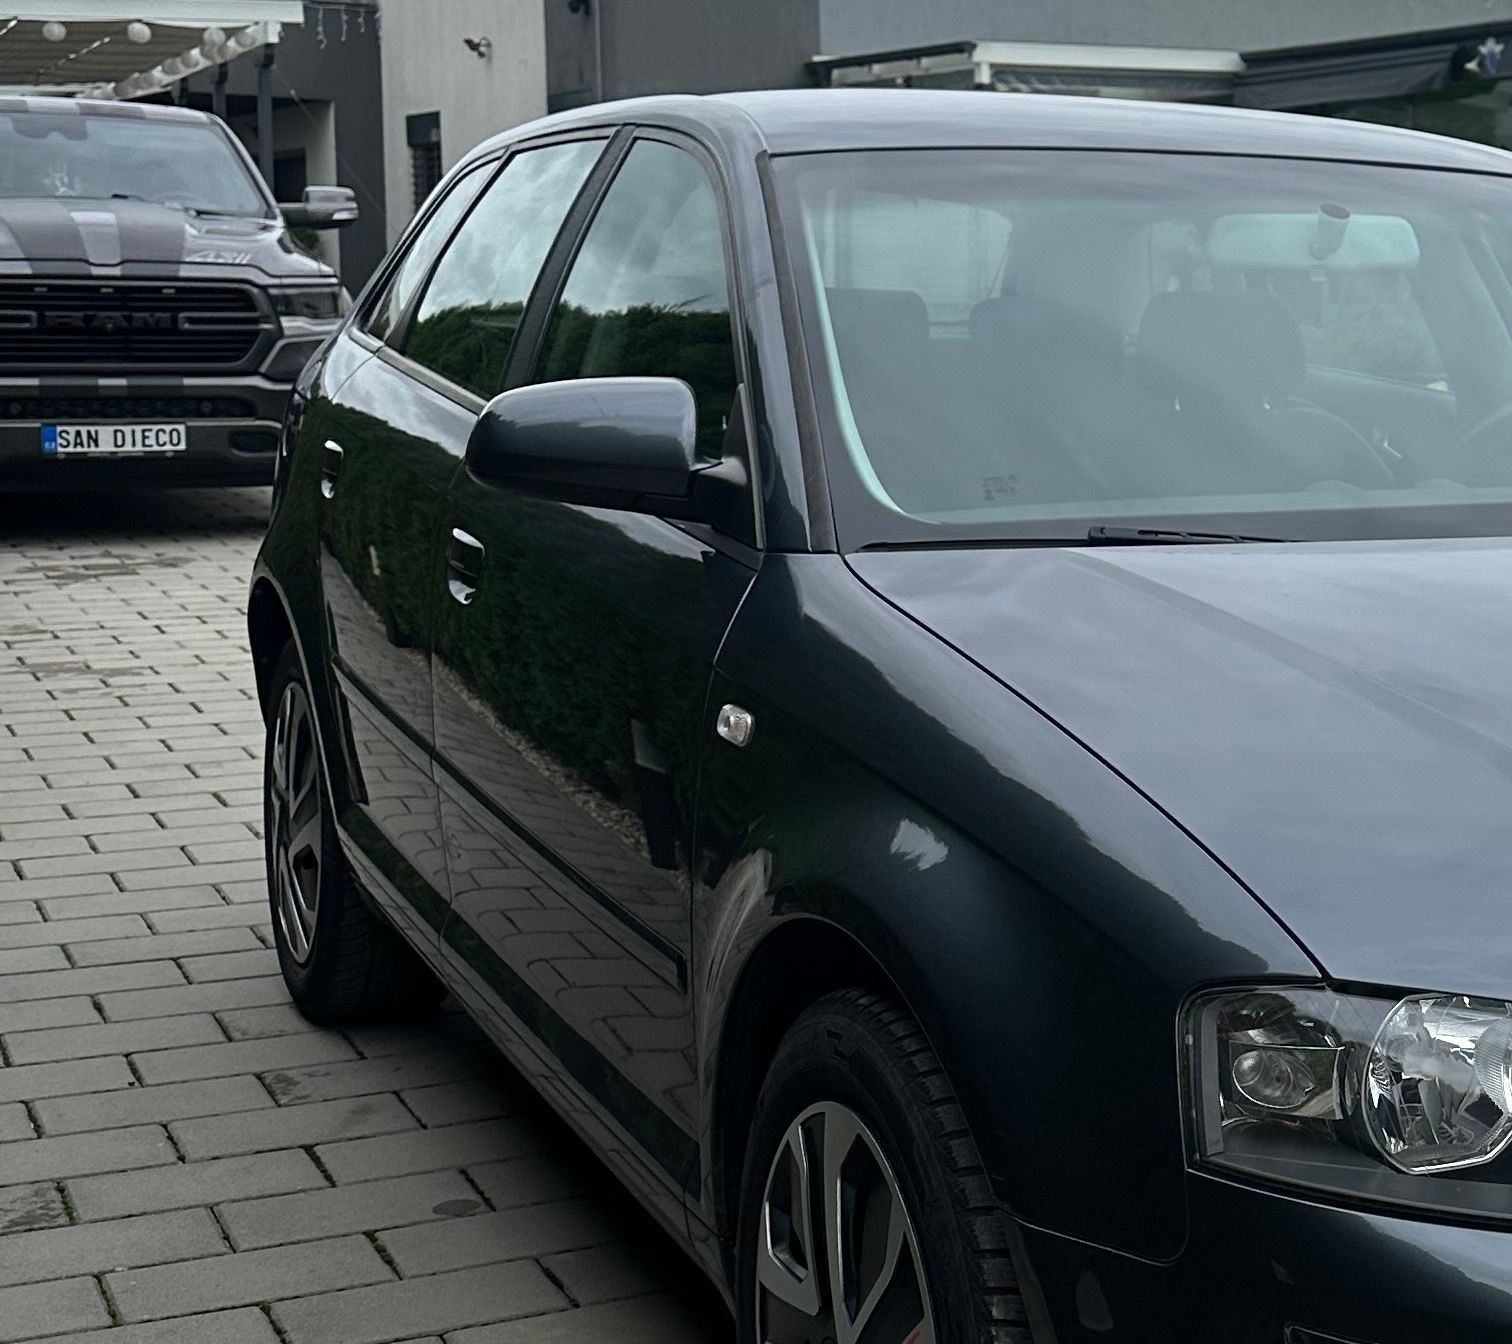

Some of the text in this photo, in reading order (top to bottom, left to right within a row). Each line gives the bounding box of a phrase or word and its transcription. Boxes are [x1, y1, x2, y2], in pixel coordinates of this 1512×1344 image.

[44, 311, 172, 329] RAM
[58, 427, 182, 449] SAN DIECO
